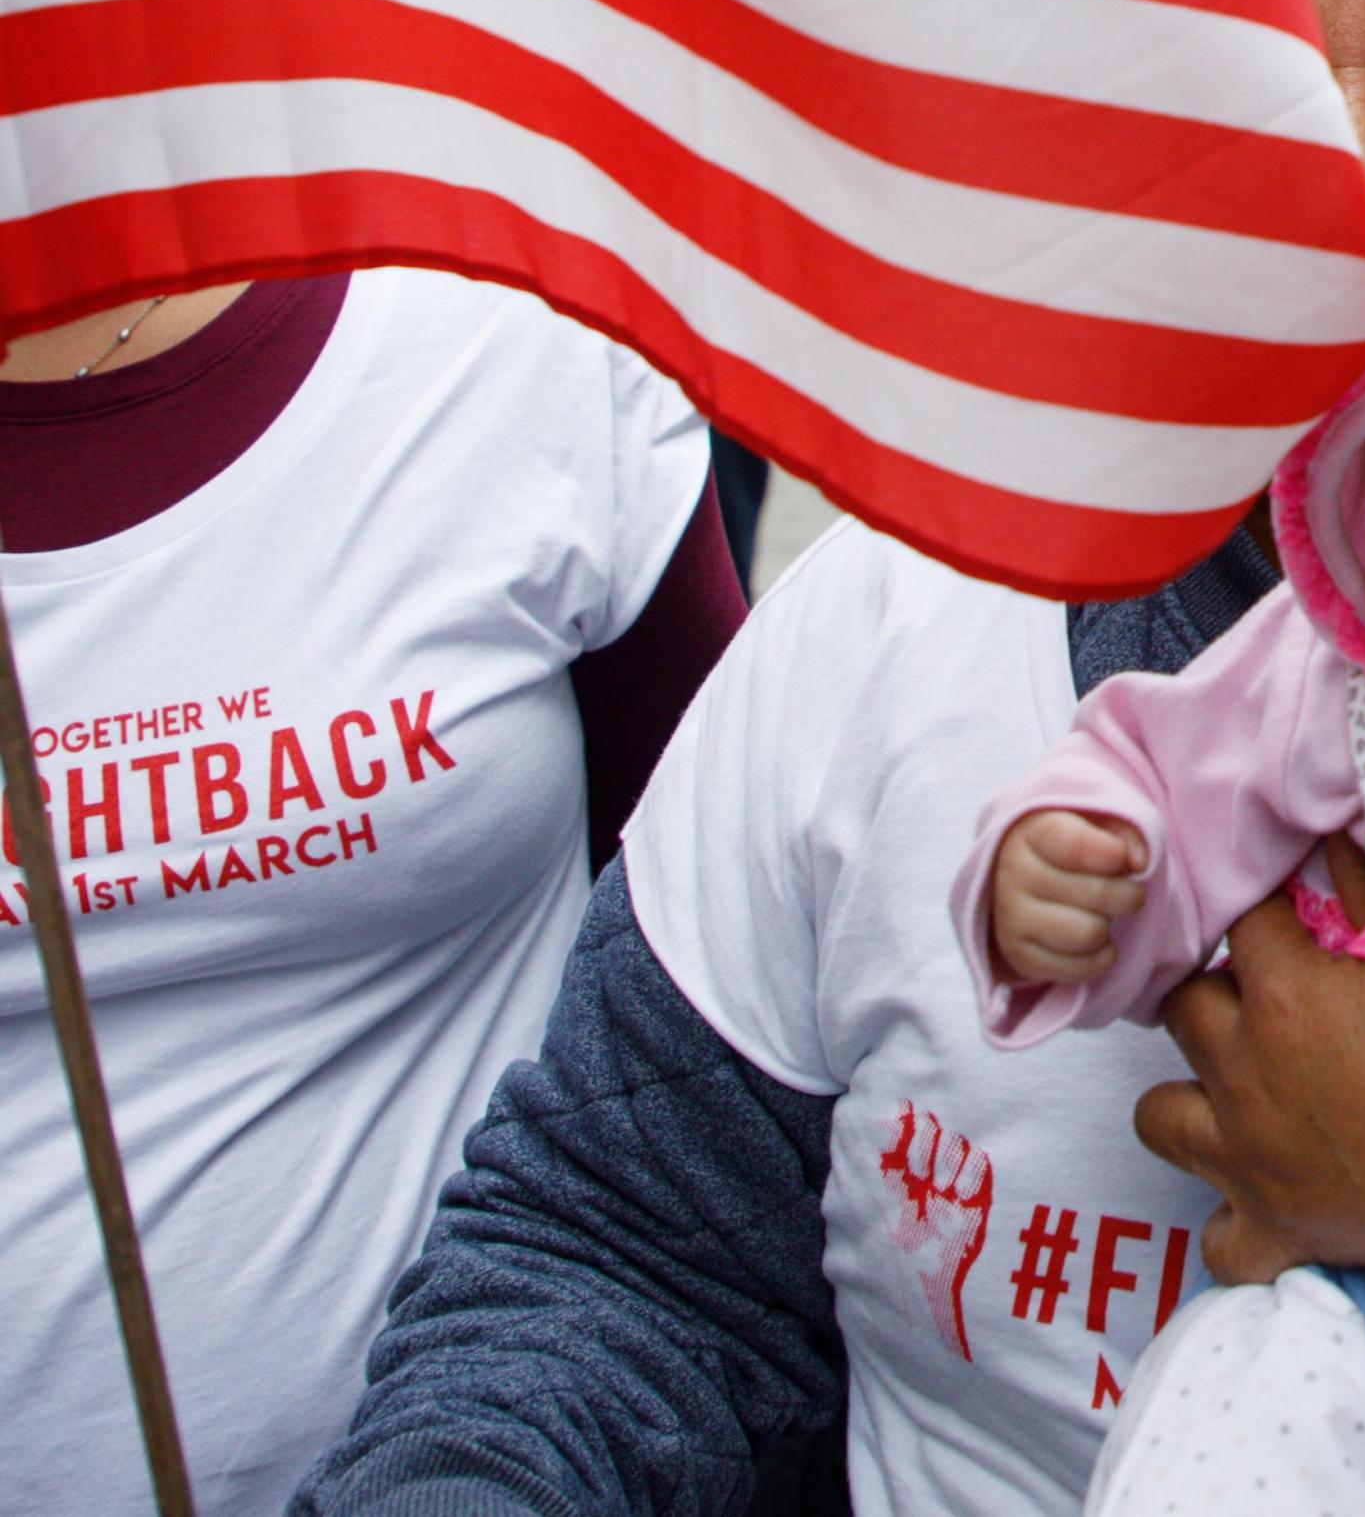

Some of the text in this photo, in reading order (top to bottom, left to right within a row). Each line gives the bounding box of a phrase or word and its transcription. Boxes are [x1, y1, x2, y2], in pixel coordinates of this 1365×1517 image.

[30, 686, 272, 758] OGETHER WE
[160, 813, 378, 899] MARCH
